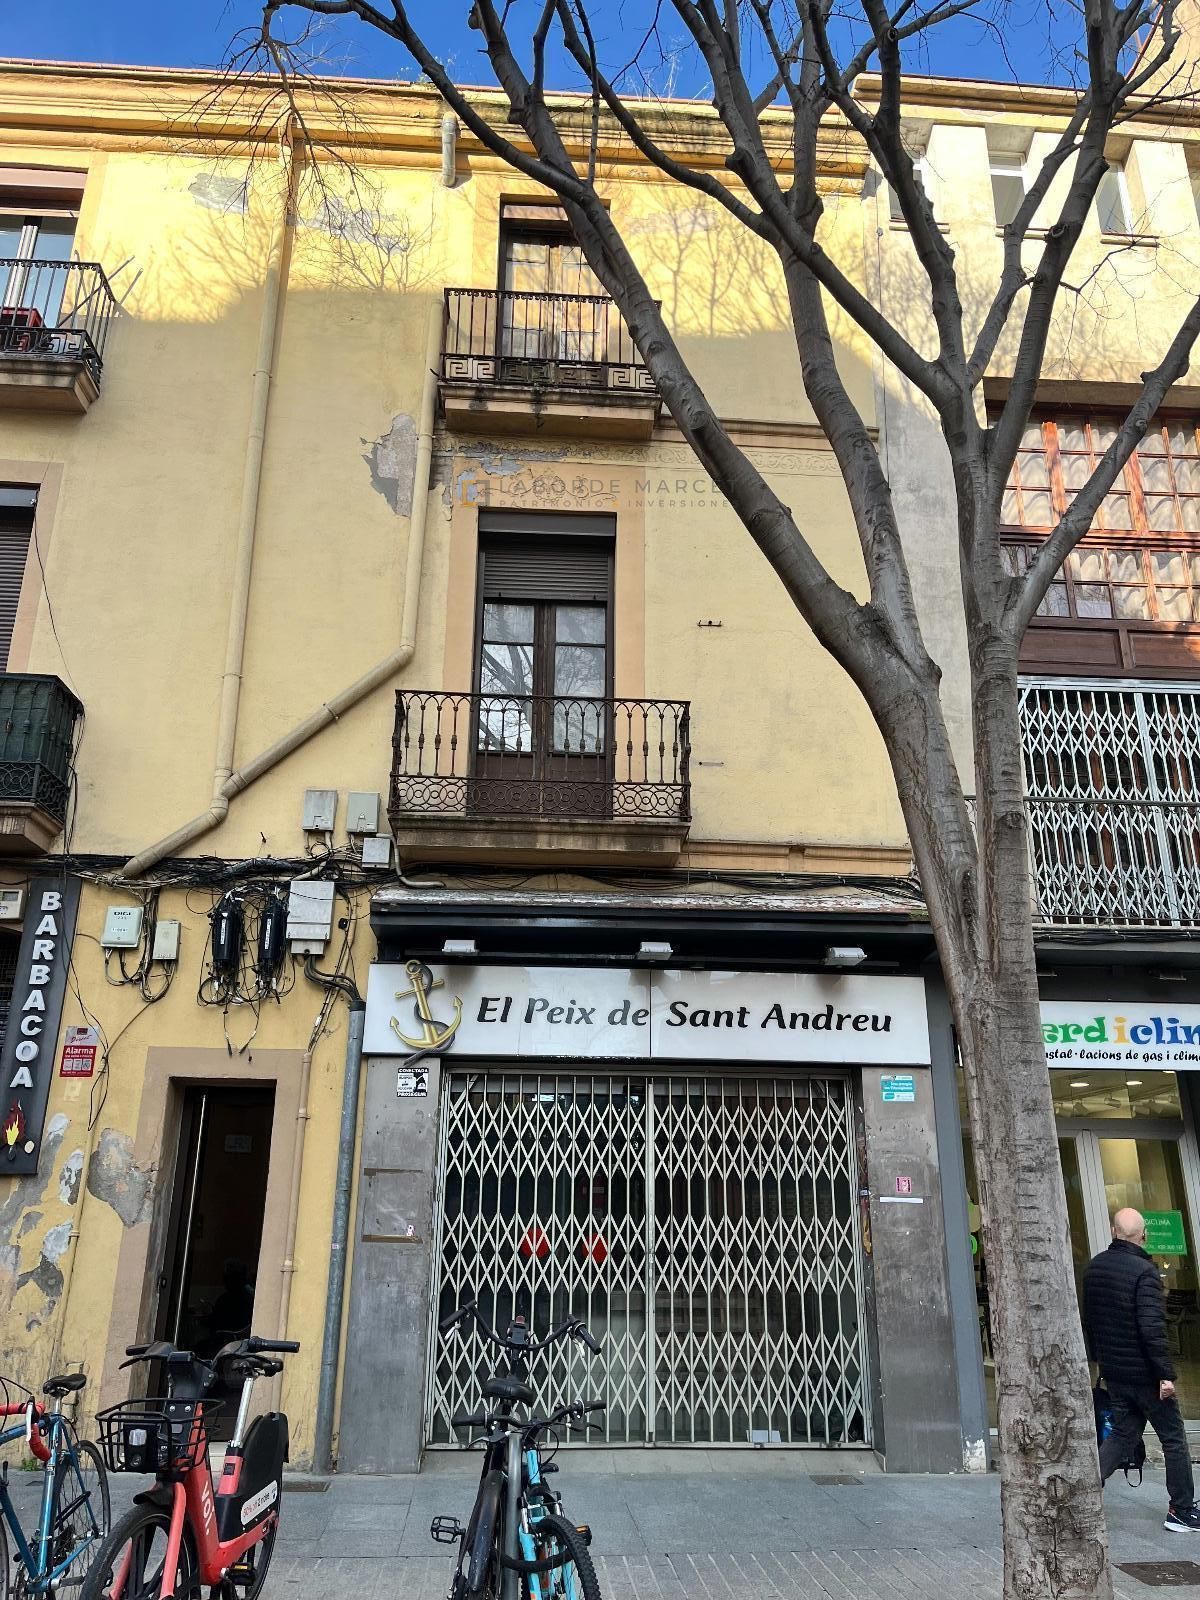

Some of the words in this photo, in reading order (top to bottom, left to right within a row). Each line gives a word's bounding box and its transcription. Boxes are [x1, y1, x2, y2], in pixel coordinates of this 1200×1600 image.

[9, 891, 62, 1088] BARBACOA
[476, 996, 513, 1023] El
[524, 998, 597, 1024] Peix
[607, 999, 650, 1026] de
[665, 1001, 751, 1028] Sant
[760, 1003, 892, 1033] Andreu
[65, 1047, 94, 1055] Alarma
[1125, 1050, 1138, 1060] de
[1142, 1052, 1163, 1063] gas
[1166, 1050, 1170, 1061] i
[1173, 1050, 1200, 1062] clim
